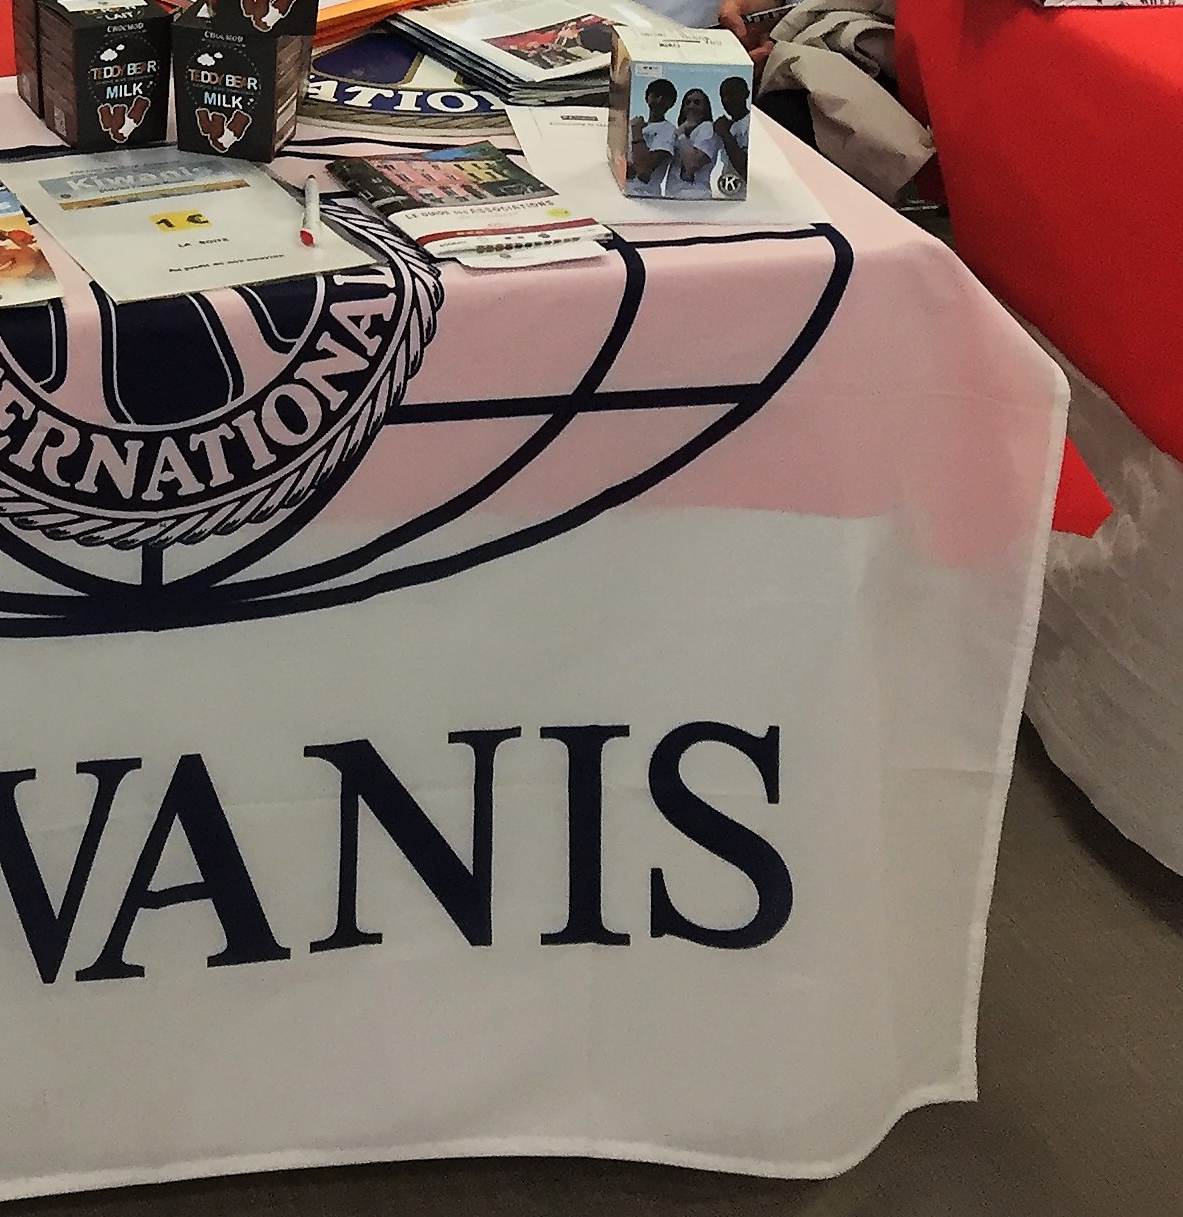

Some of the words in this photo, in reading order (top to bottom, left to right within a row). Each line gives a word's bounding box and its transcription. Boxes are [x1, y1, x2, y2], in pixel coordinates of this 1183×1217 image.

[89, 65, 126, 80] TEDDY
[188, 68, 224, 85] TEDDY
[225, 74, 258, 91] BEAR
[106, 82, 144, 99] MILK
[203, 91, 243, 110] MILK
[469, 200, 555, 215] ASSOCIATIONS
